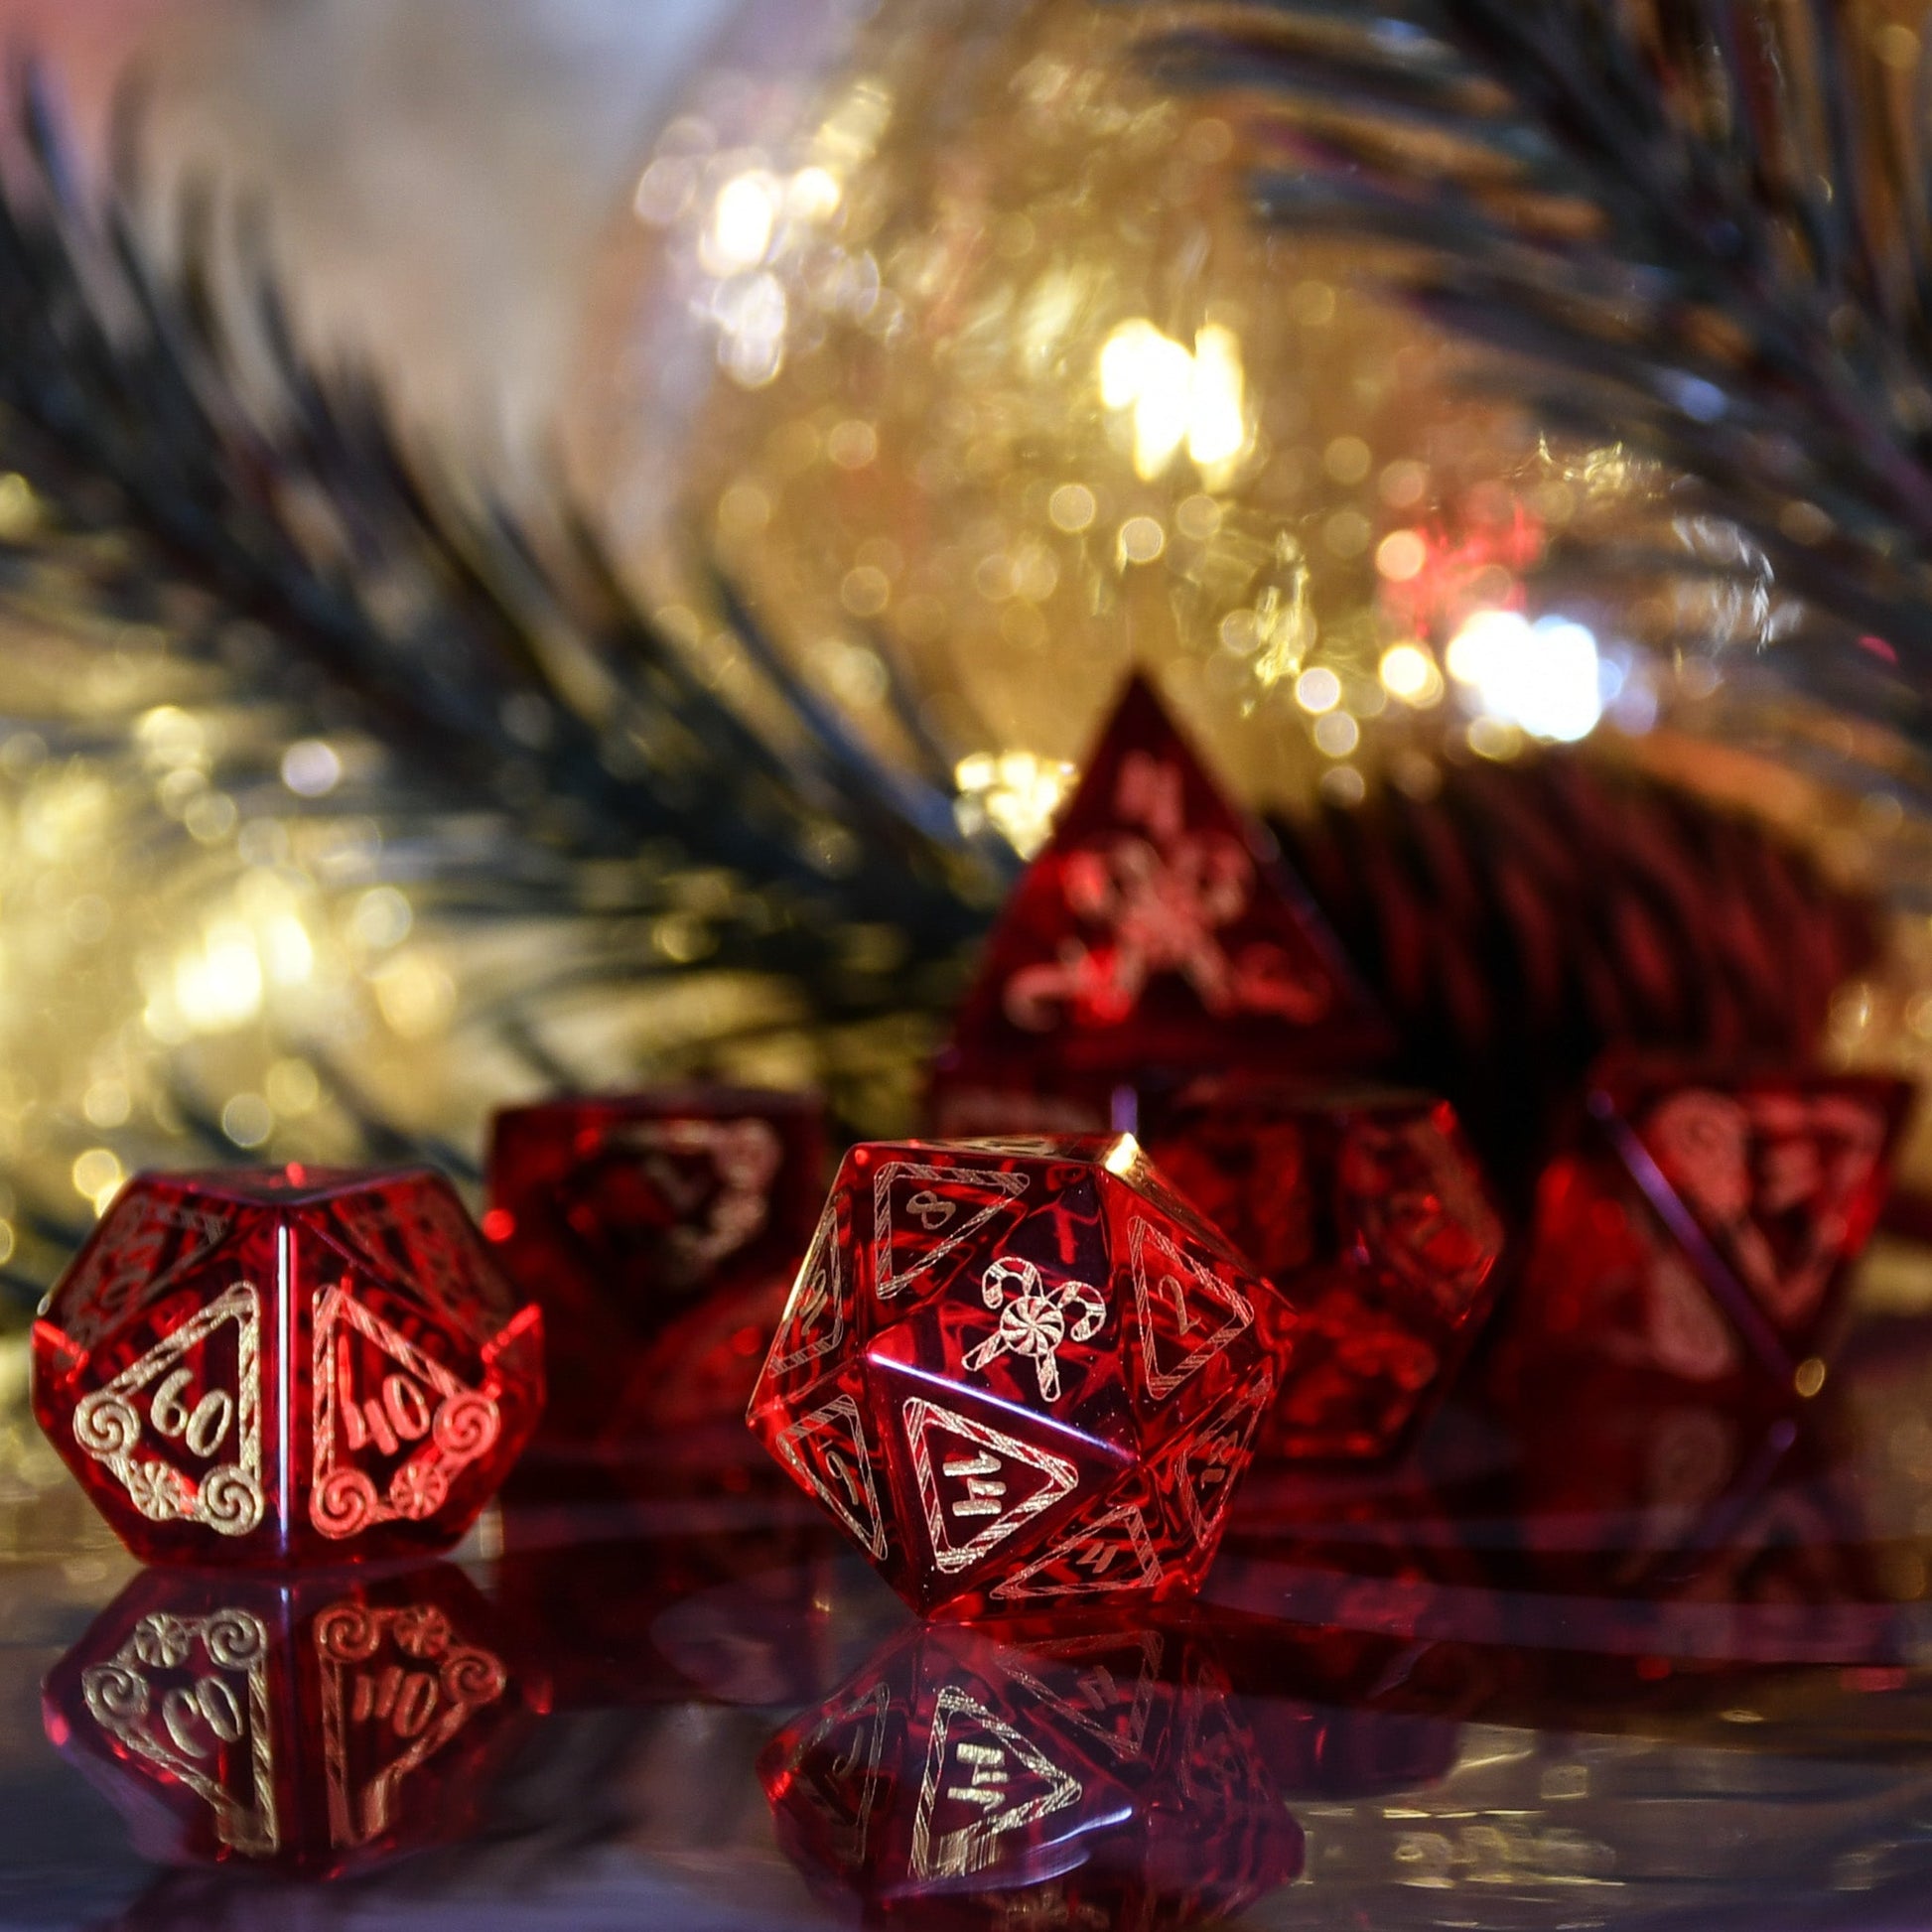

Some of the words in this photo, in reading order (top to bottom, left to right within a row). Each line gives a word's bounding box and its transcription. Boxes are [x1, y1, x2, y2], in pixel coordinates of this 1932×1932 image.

[906, 1190, 956, 1230] 8
[1158, 1275, 1201, 1336] 2
[150, 1366, 233, 1457] 60
[343, 1374, 431, 1456] 40
[943, 1449, 1007, 1517] 14
